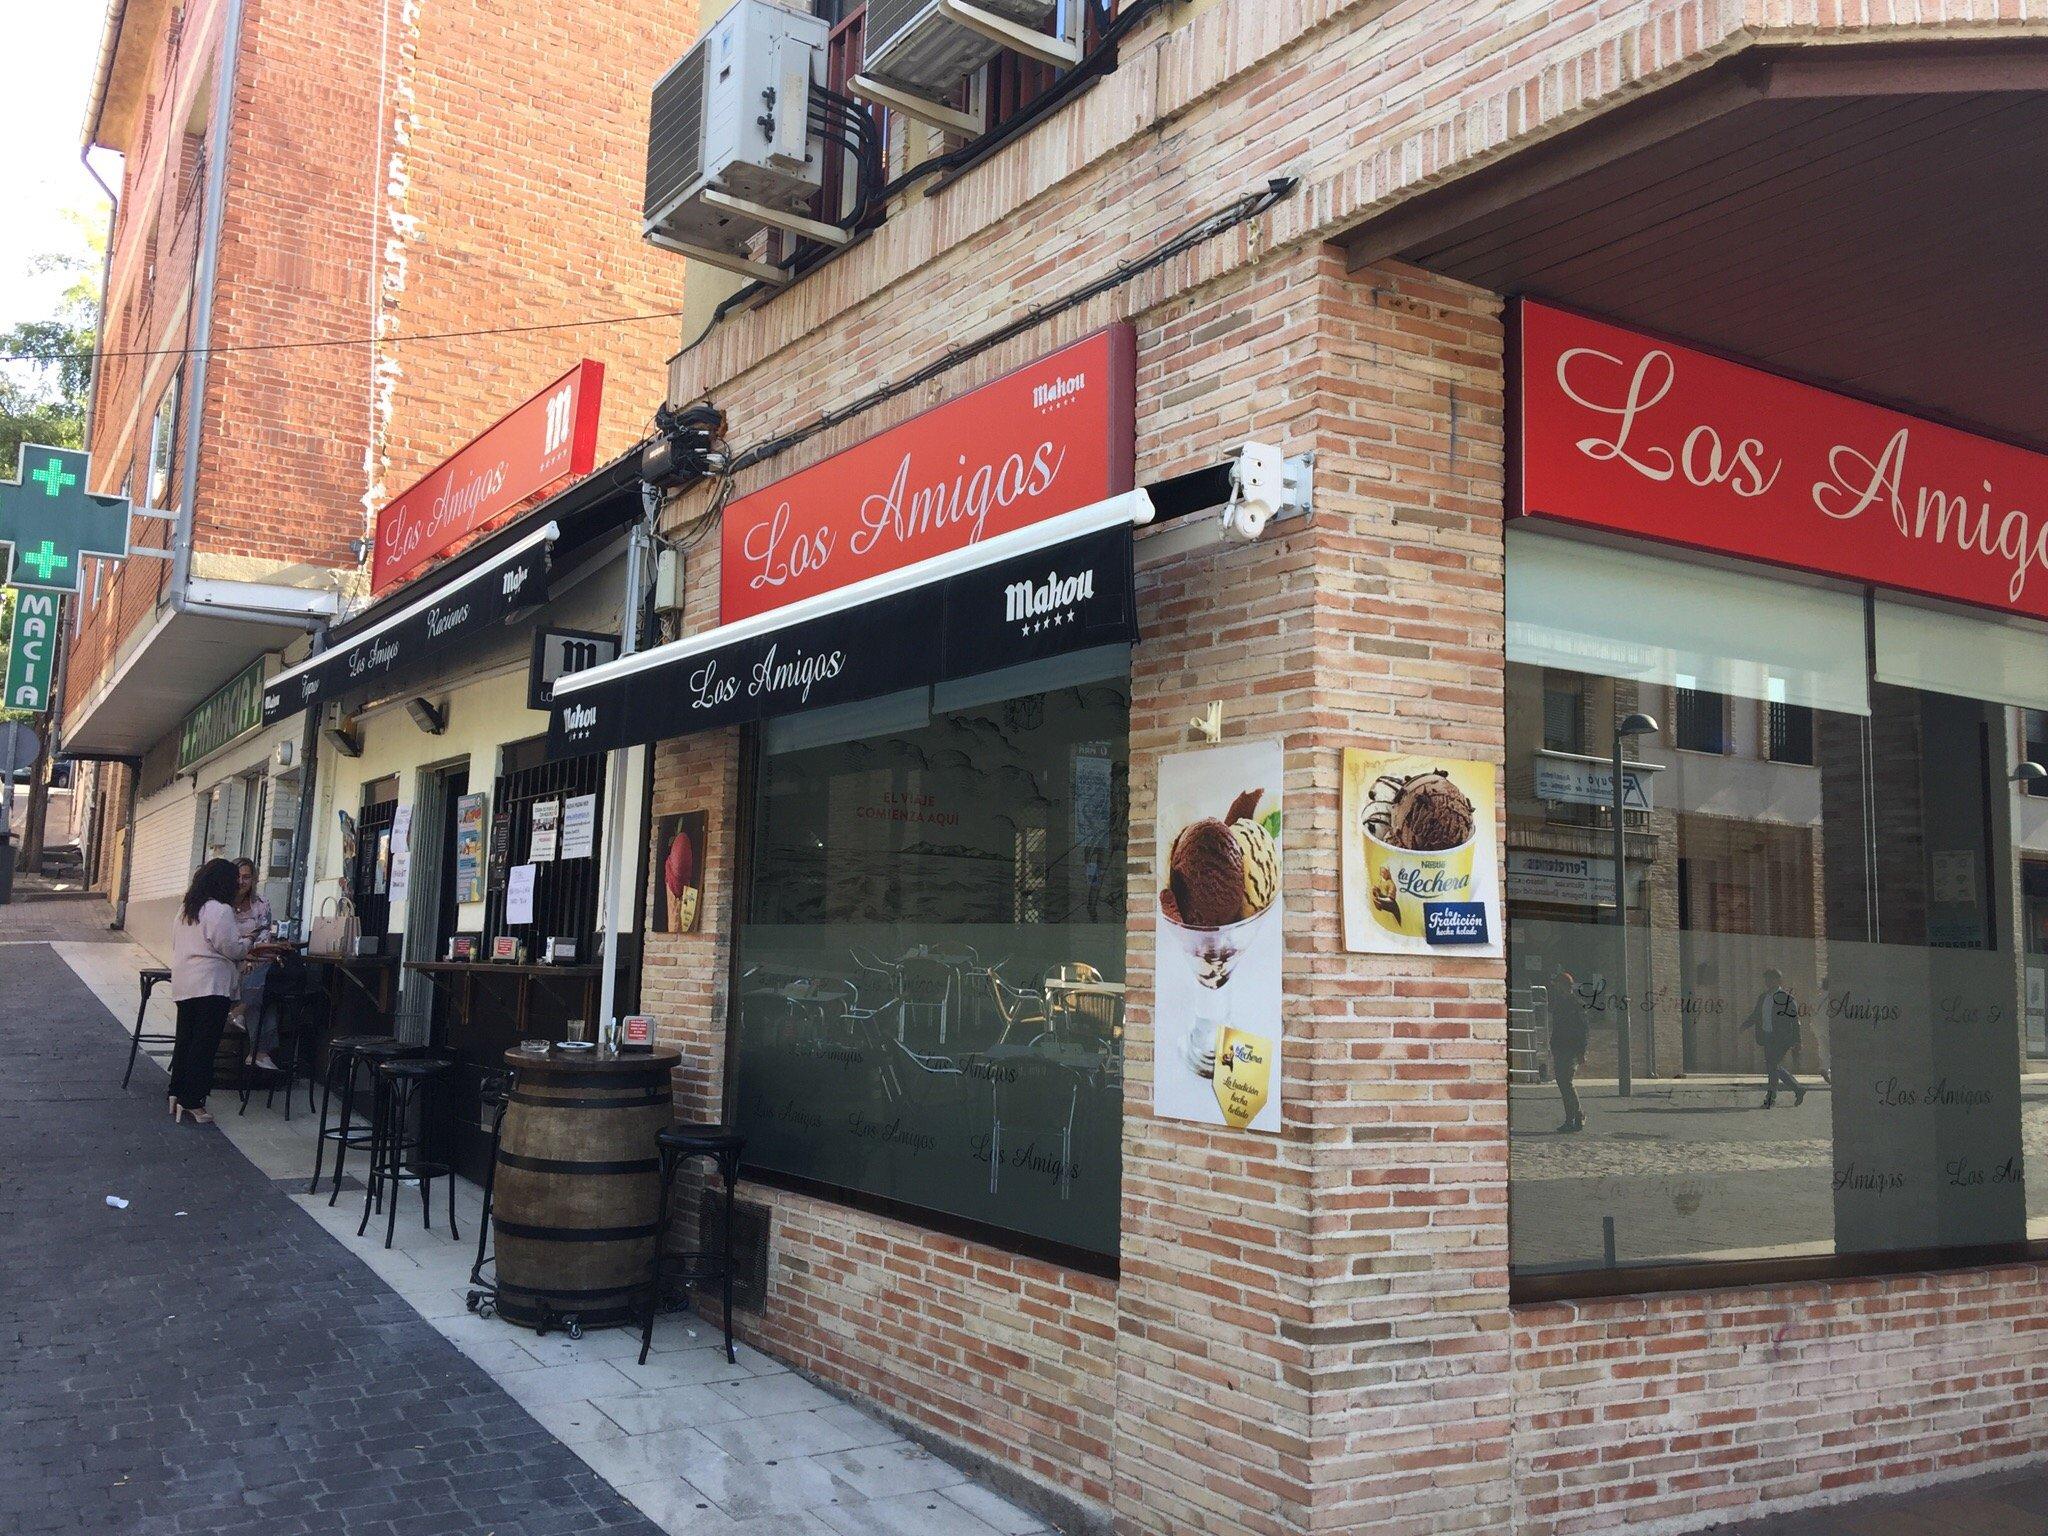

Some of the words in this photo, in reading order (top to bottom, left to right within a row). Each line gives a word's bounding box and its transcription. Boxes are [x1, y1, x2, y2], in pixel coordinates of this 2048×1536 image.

[1033, 371, 1085, 409] Mahou
[1556, 347, 1782, 497] Los
[1812, 428, 2048, 603] Amig
[384, 512, 421, 566] Los
[424, 459, 509, 549] Amigos
[743, 501, 836, 590] Los
[850, 439, 1066, 545] Amigos
[1004, 568, 1094, 622] Mahou
[349, 648, 365, 677] Los
[368, 638, 400, 670] Amigos
[689, 658, 741, 709] Los
[747, 643, 846, 704] Amigos
[564, 704, 597, 733] Mahou
[1429, 912, 1483, 928] Tradición
[1829, 990, 1900, 1030] Amigos
[1875, 1077, 1917, 1107] Los
[1923, 1077, 1995, 1115] Amigos
[1012, 1143, 1083, 1186] Amigs
